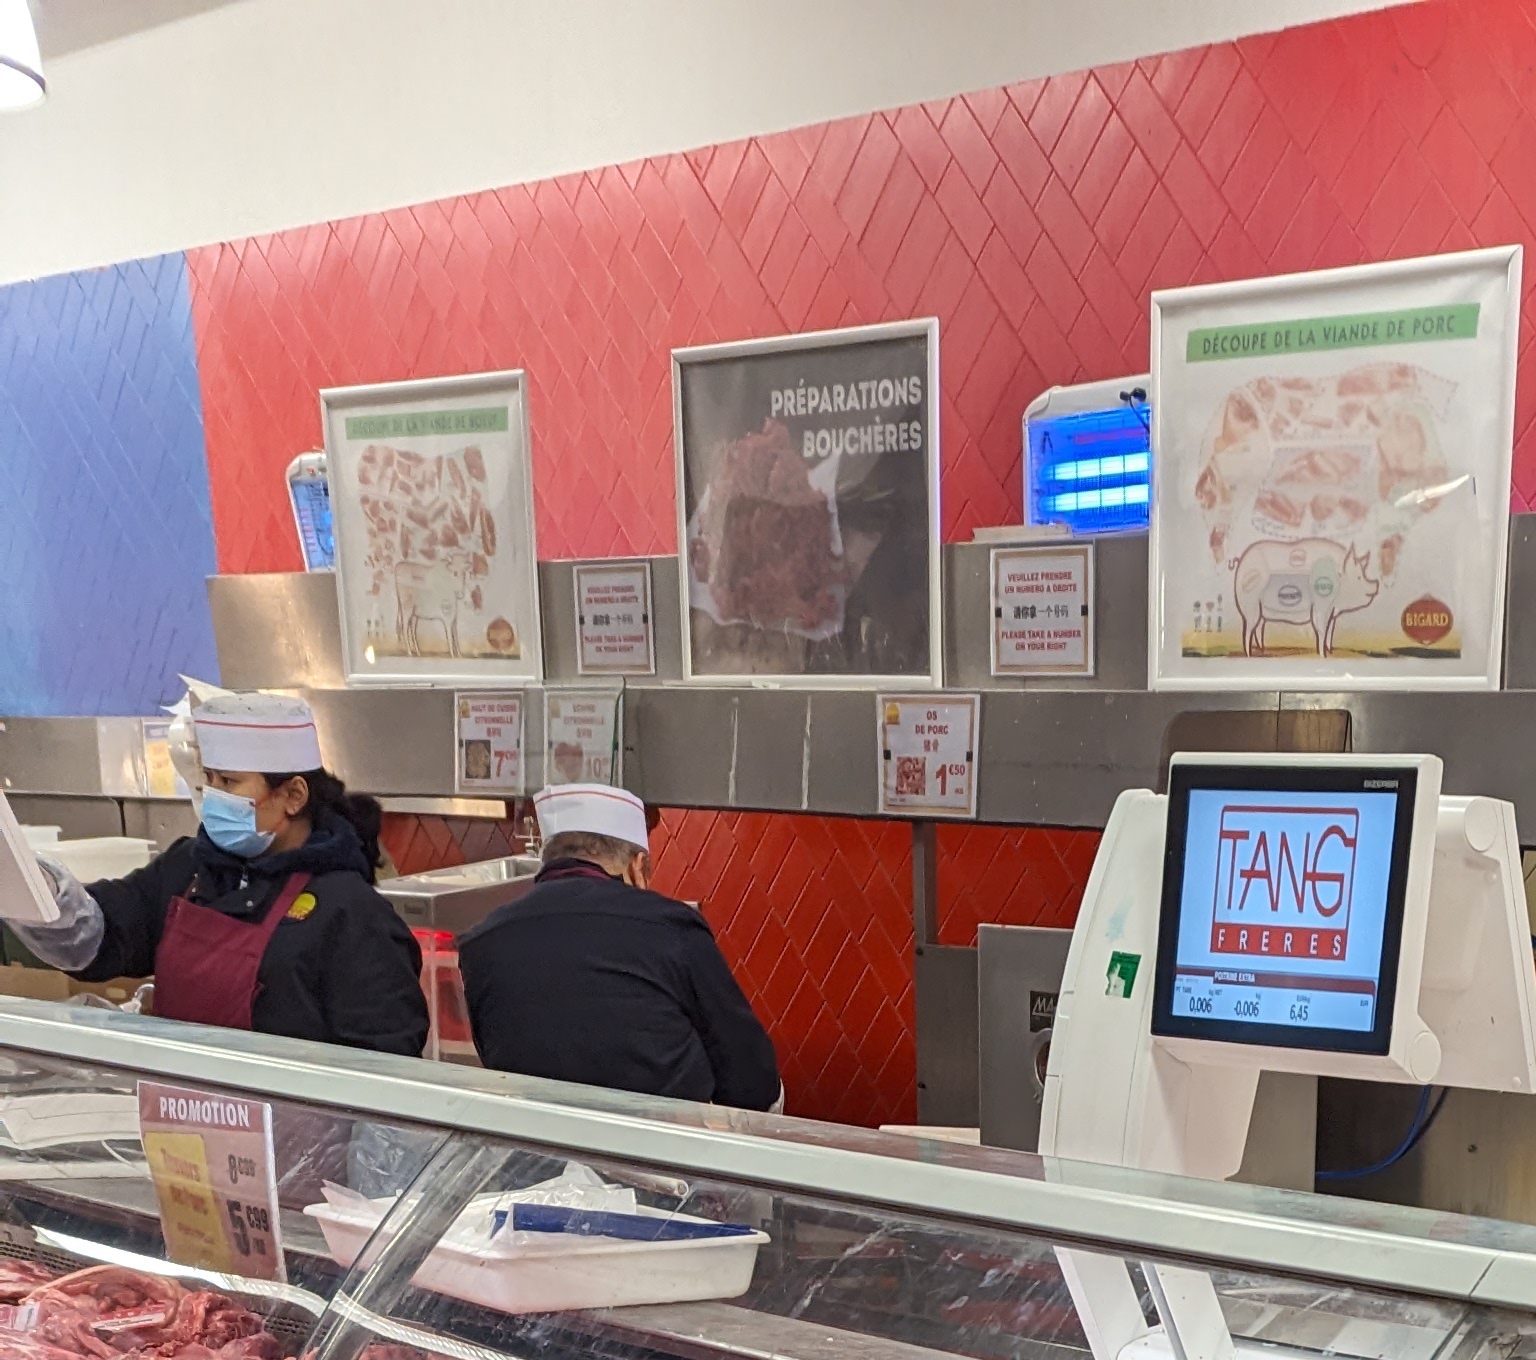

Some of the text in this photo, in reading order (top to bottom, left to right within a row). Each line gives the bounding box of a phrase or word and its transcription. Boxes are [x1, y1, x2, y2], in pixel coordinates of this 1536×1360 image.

[1203, 315, 1456, 355] DÉCOUPE DE LA VIANDE DE PORC
[770, 376, 922, 417] PRÉPARATIONS
[803, 415, 922, 458] BOUCHÈRES
[1406, 613, 1449, 627] BIGARD
[915, 724, 949, 734] DE PORC
[926, 711, 938, 720] OS
[494, 751, 505, 778] 7
[936, 764, 966, 796] 1 €50
[1220, 824, 1357, 918] TANG
[1216, 928, 1342, 956] FRERES
[1289, 1004, 1309, 1021] 6,45
[159, 1096, 250, 1128] PROMOTION
[228, 1154, 239, 1185] 8
[227, 1200, 249, 1256] 5
[246, 1206, 269, 1232] €99
